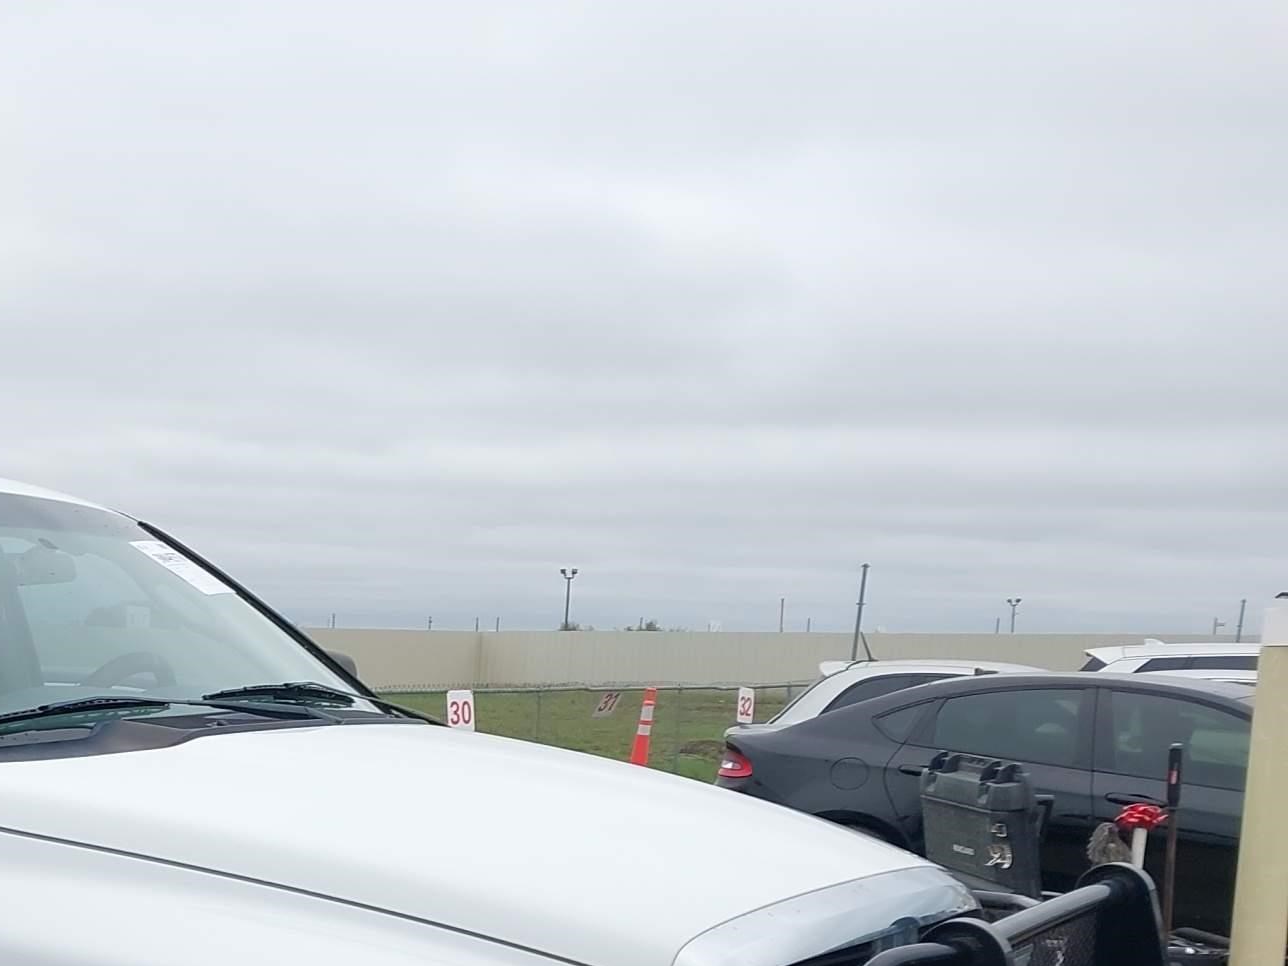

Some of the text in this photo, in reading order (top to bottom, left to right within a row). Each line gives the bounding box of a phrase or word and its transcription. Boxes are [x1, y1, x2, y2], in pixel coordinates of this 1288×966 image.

[598, 692, 620, 711] 31
[739, 696, 752, 716] 32
[450, 700, 472, 725] 30
